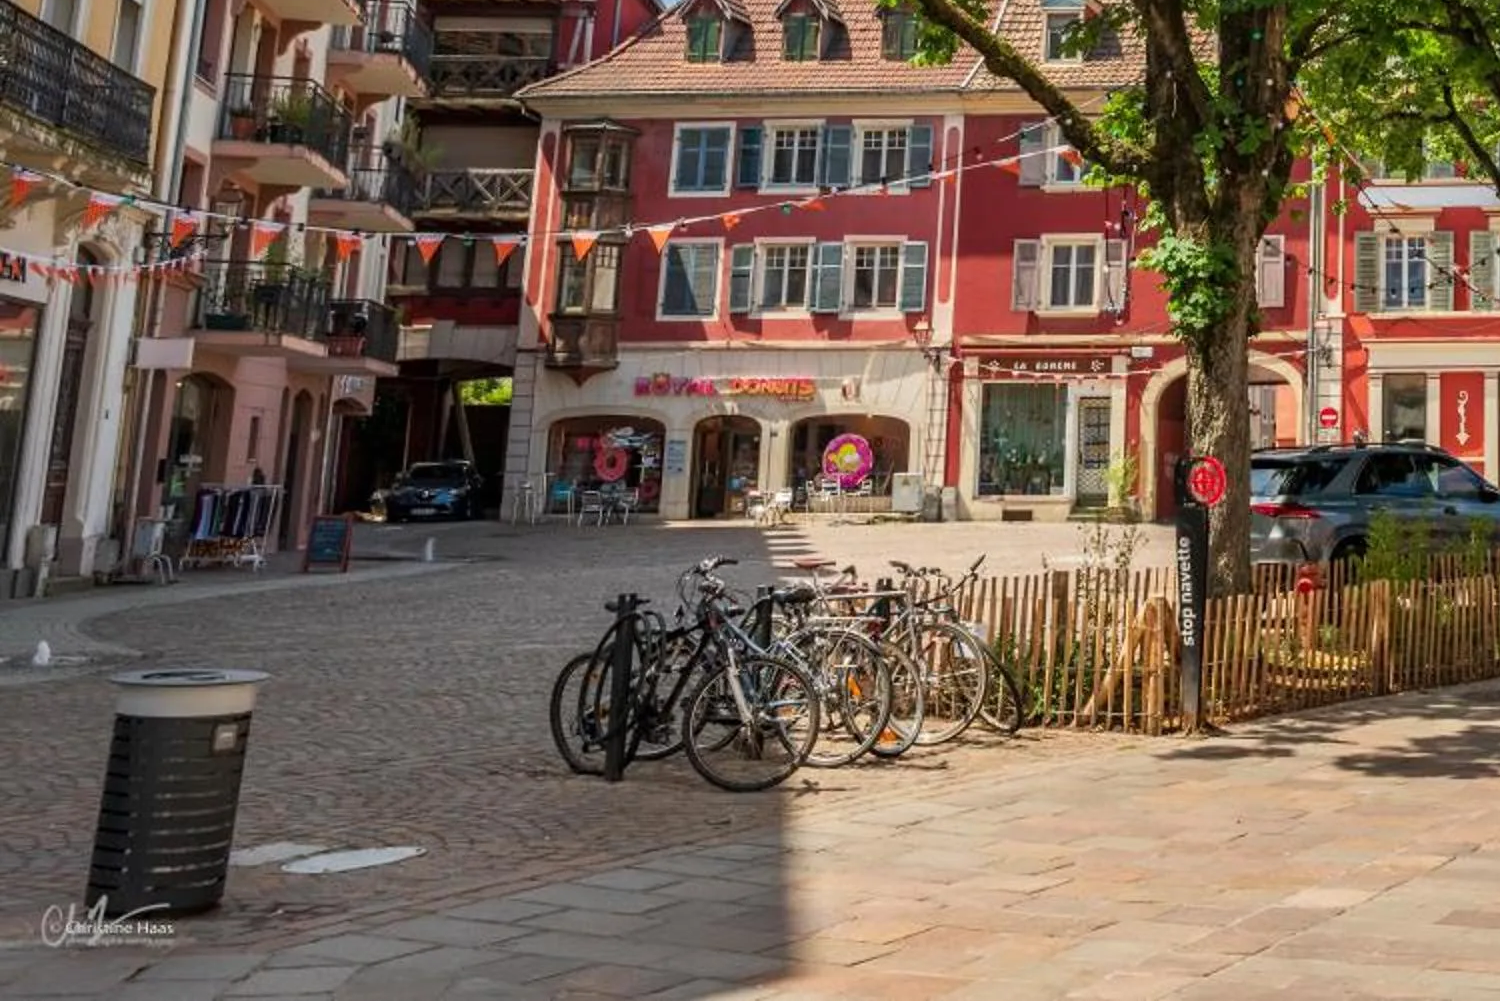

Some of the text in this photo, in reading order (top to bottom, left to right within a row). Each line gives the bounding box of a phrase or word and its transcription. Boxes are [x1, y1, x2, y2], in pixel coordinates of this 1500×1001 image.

[634, 373, 816, 396] ROYAL DONUTS
[1177, 536, 1197, 647] stop navette
